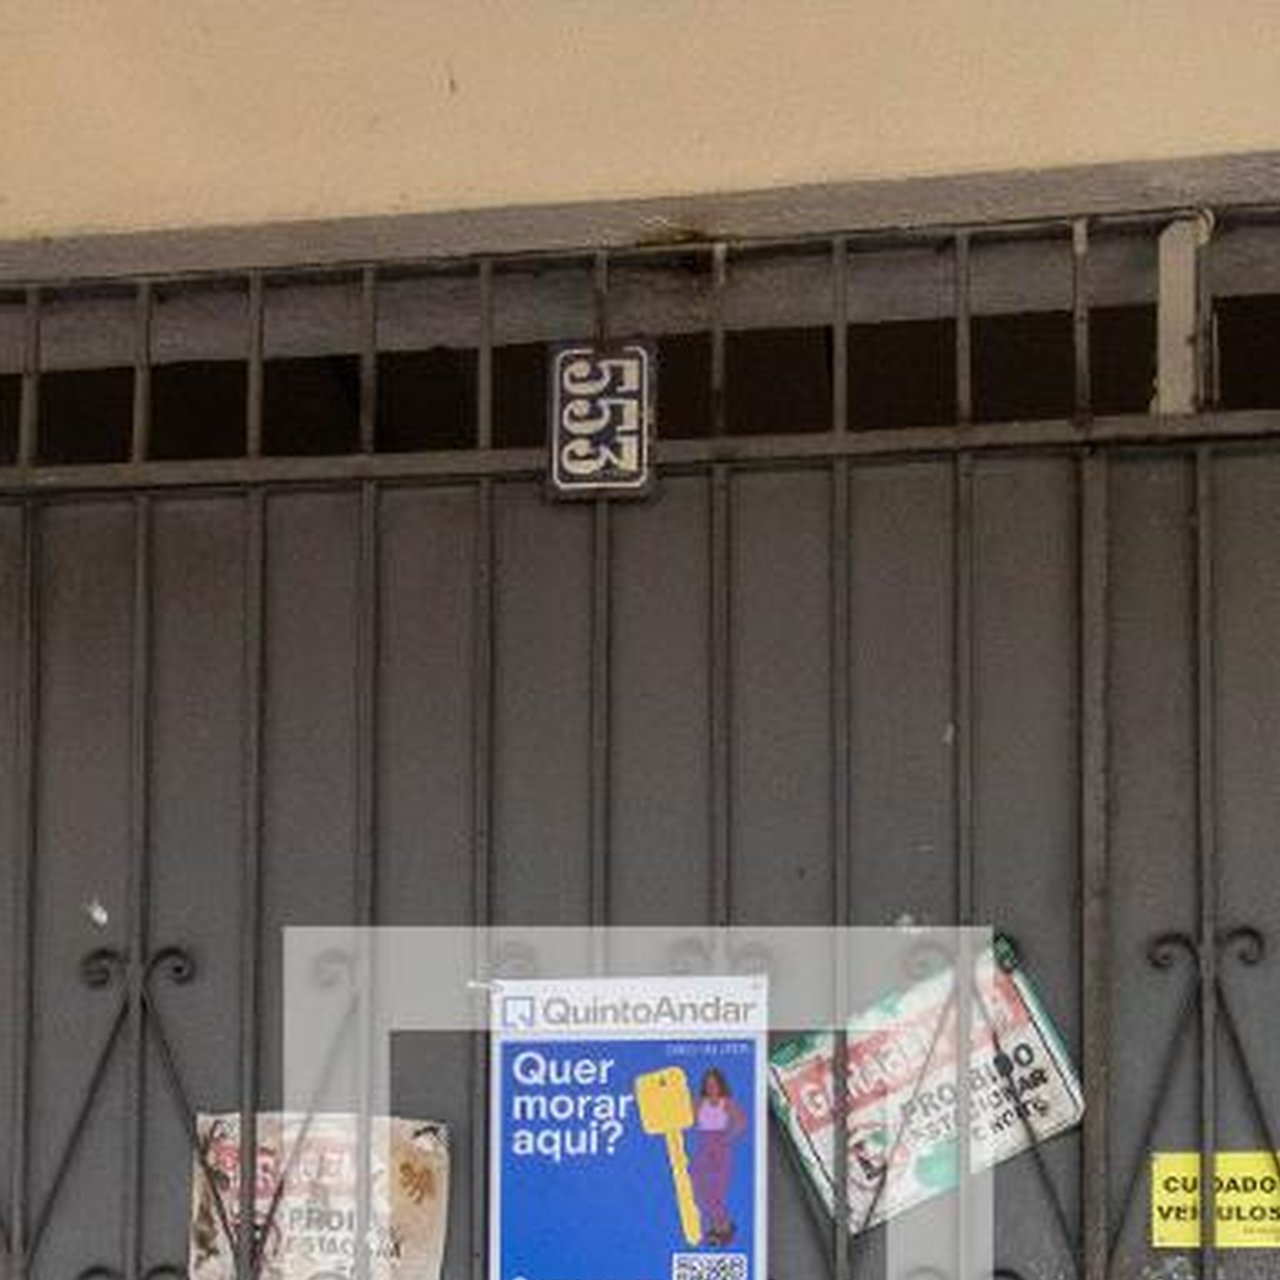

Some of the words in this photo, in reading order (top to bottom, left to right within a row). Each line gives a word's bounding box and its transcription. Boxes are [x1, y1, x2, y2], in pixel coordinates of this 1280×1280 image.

[562, 360, 639, 475] 553
[543, 997, 757, 1026] QuintoAndar
[512, 1051, 615, 1086] Quer
[513, 1094, 634, 1121] morar
[513, 1121, 623, 1162] aqui?
